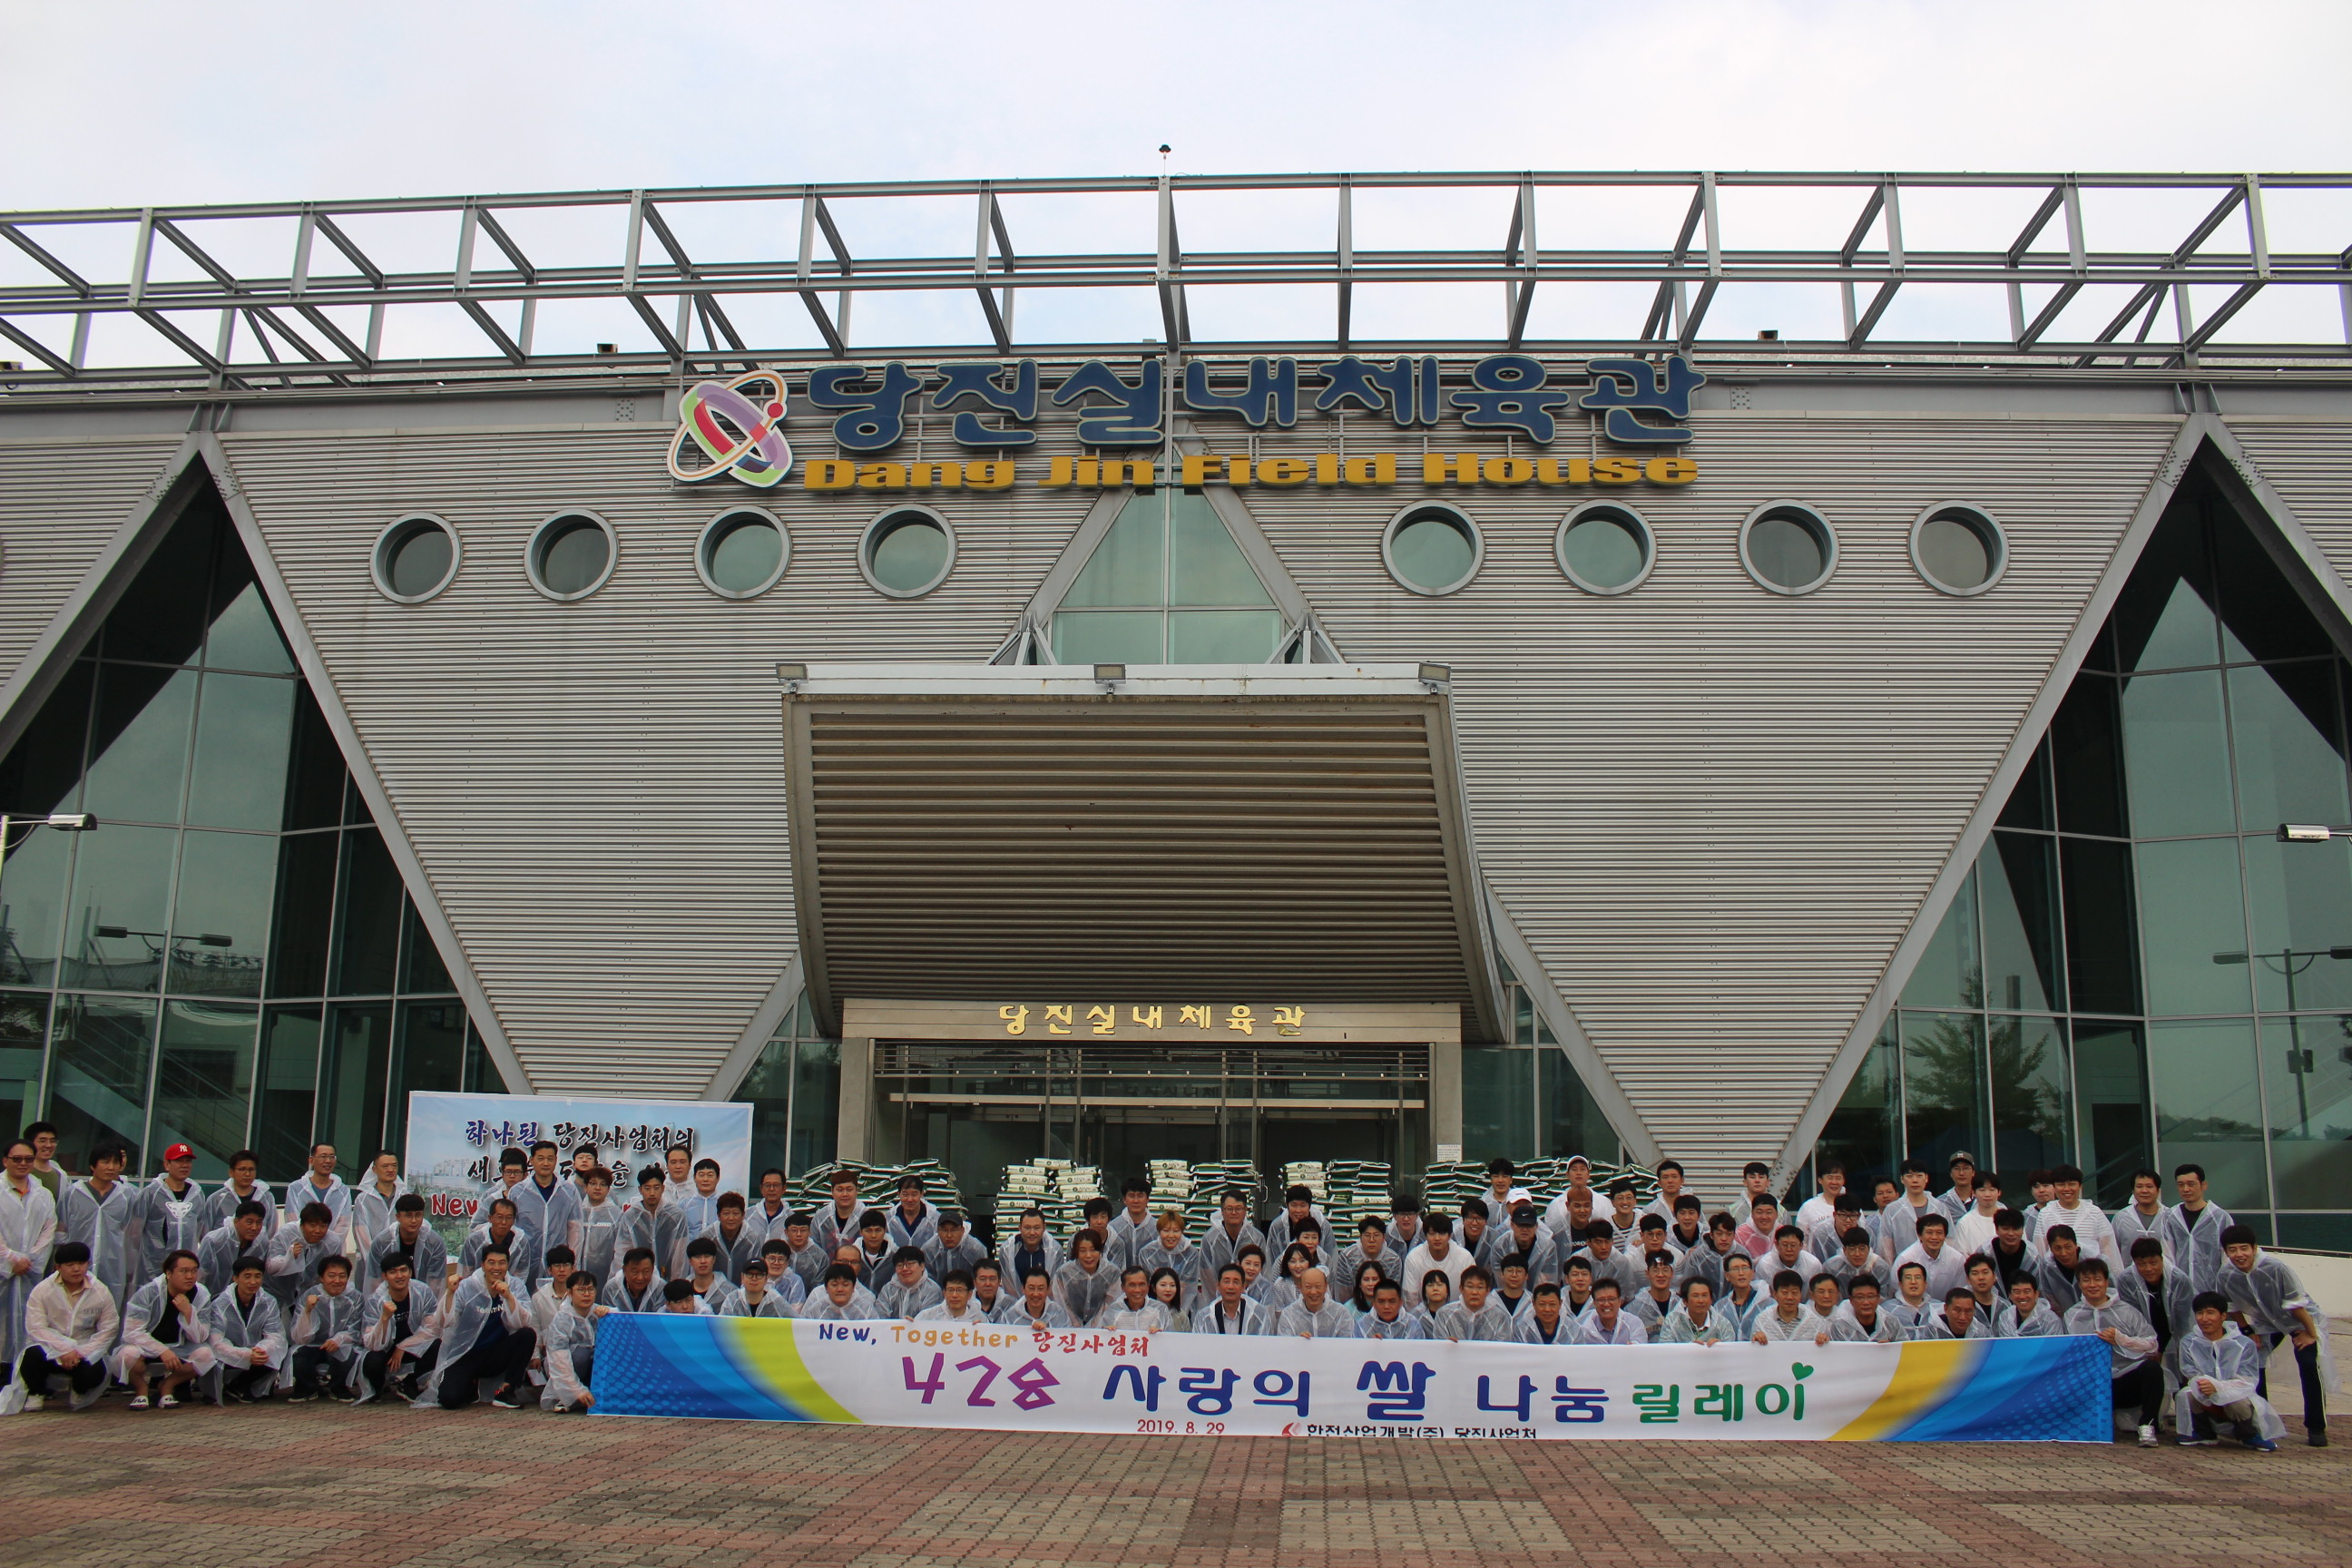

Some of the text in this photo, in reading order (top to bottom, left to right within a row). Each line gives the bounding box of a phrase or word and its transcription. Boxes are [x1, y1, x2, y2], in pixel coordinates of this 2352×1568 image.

[807, 357, 1708, 448] 당진실내체육관
[803, 452, 1699, 492] Dang Jin Field House
[998, 1004, 1306, 1036] 당진실내체육관
[465, 1119, 695, 1152] 하나된 당진사업처의
[818, 1322, 1151, 1357] New, Together 당진사업처
[1102, 1363, 1310, 1418] 사랑의
[1356, 1360, 1436, 1422] 쌀
[1476, 1374, 1610, 1424] 나눔
[1632, 1376, 1808, 1423] 릴레이
[1136, 1417, 1226, 1435] 2019. 8. 29
